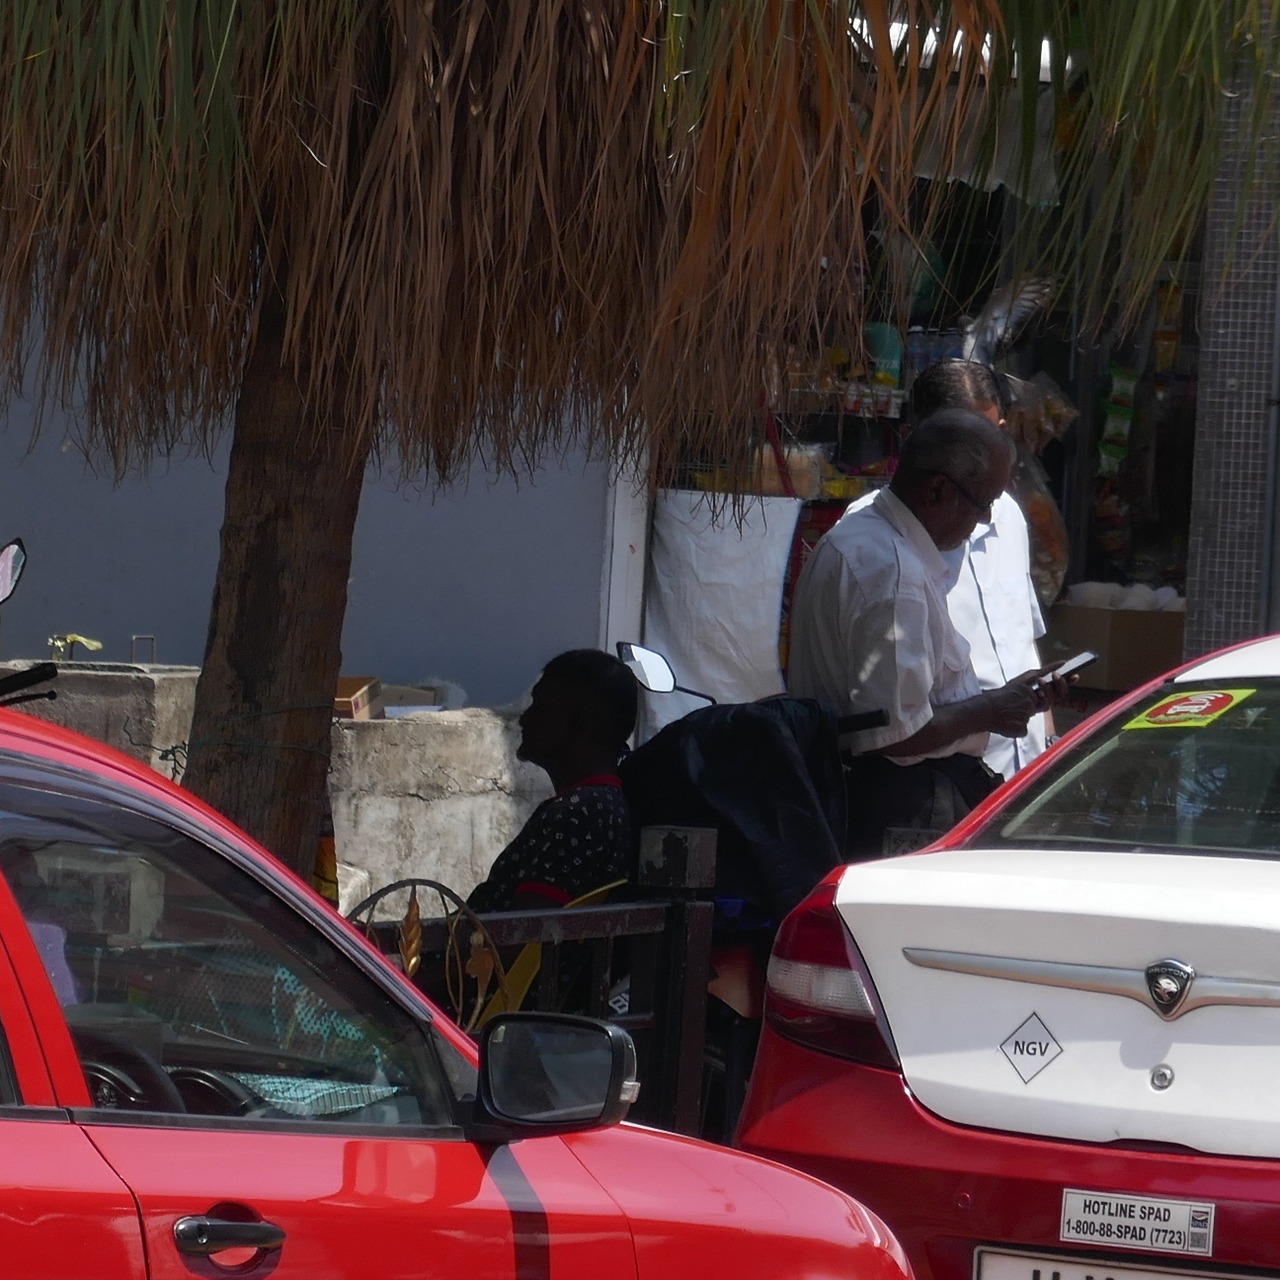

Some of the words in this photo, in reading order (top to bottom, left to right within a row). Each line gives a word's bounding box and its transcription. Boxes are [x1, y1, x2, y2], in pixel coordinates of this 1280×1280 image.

[1149, 966, 1188, 979] PROTON
[1013, 1040, 1050, 1058] NGV
[1083, 1199, 1137, 1219] HOTLINE
[1139, 1205, 1171, 1222] SPAD
[1066, 1218, 1147, 1241] 1-800-88-SPAD
[1150, 1228, 1187, 1249] (7723)
